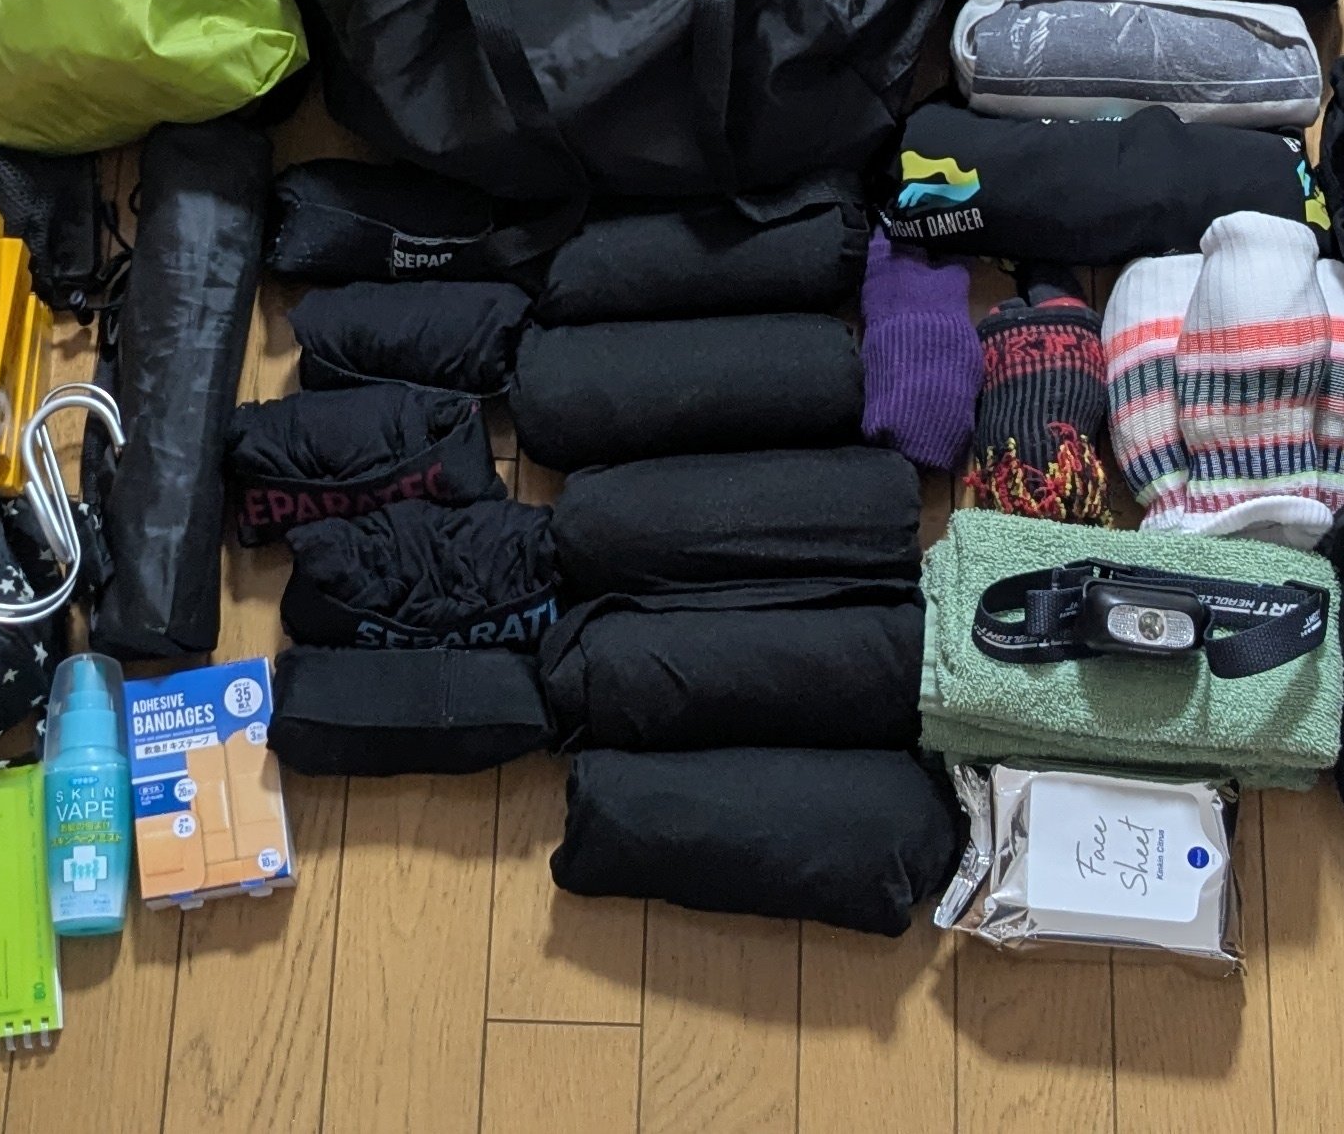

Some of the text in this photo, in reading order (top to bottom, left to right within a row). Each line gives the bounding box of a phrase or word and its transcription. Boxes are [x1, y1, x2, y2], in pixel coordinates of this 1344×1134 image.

[926, 208, 984, 237] DANCER
[133, 693, 185, 715] ADHESIVE
[235, 686, 251, 703] 35
[133, 704, 215, 736] BANDAGES
[56, 787, 115, 803] SKIN
[56, 800, 115, 822] VAPE
[1076, 815, 1107, 879] Face
[1113, 815, 1154, 896] Sheet
